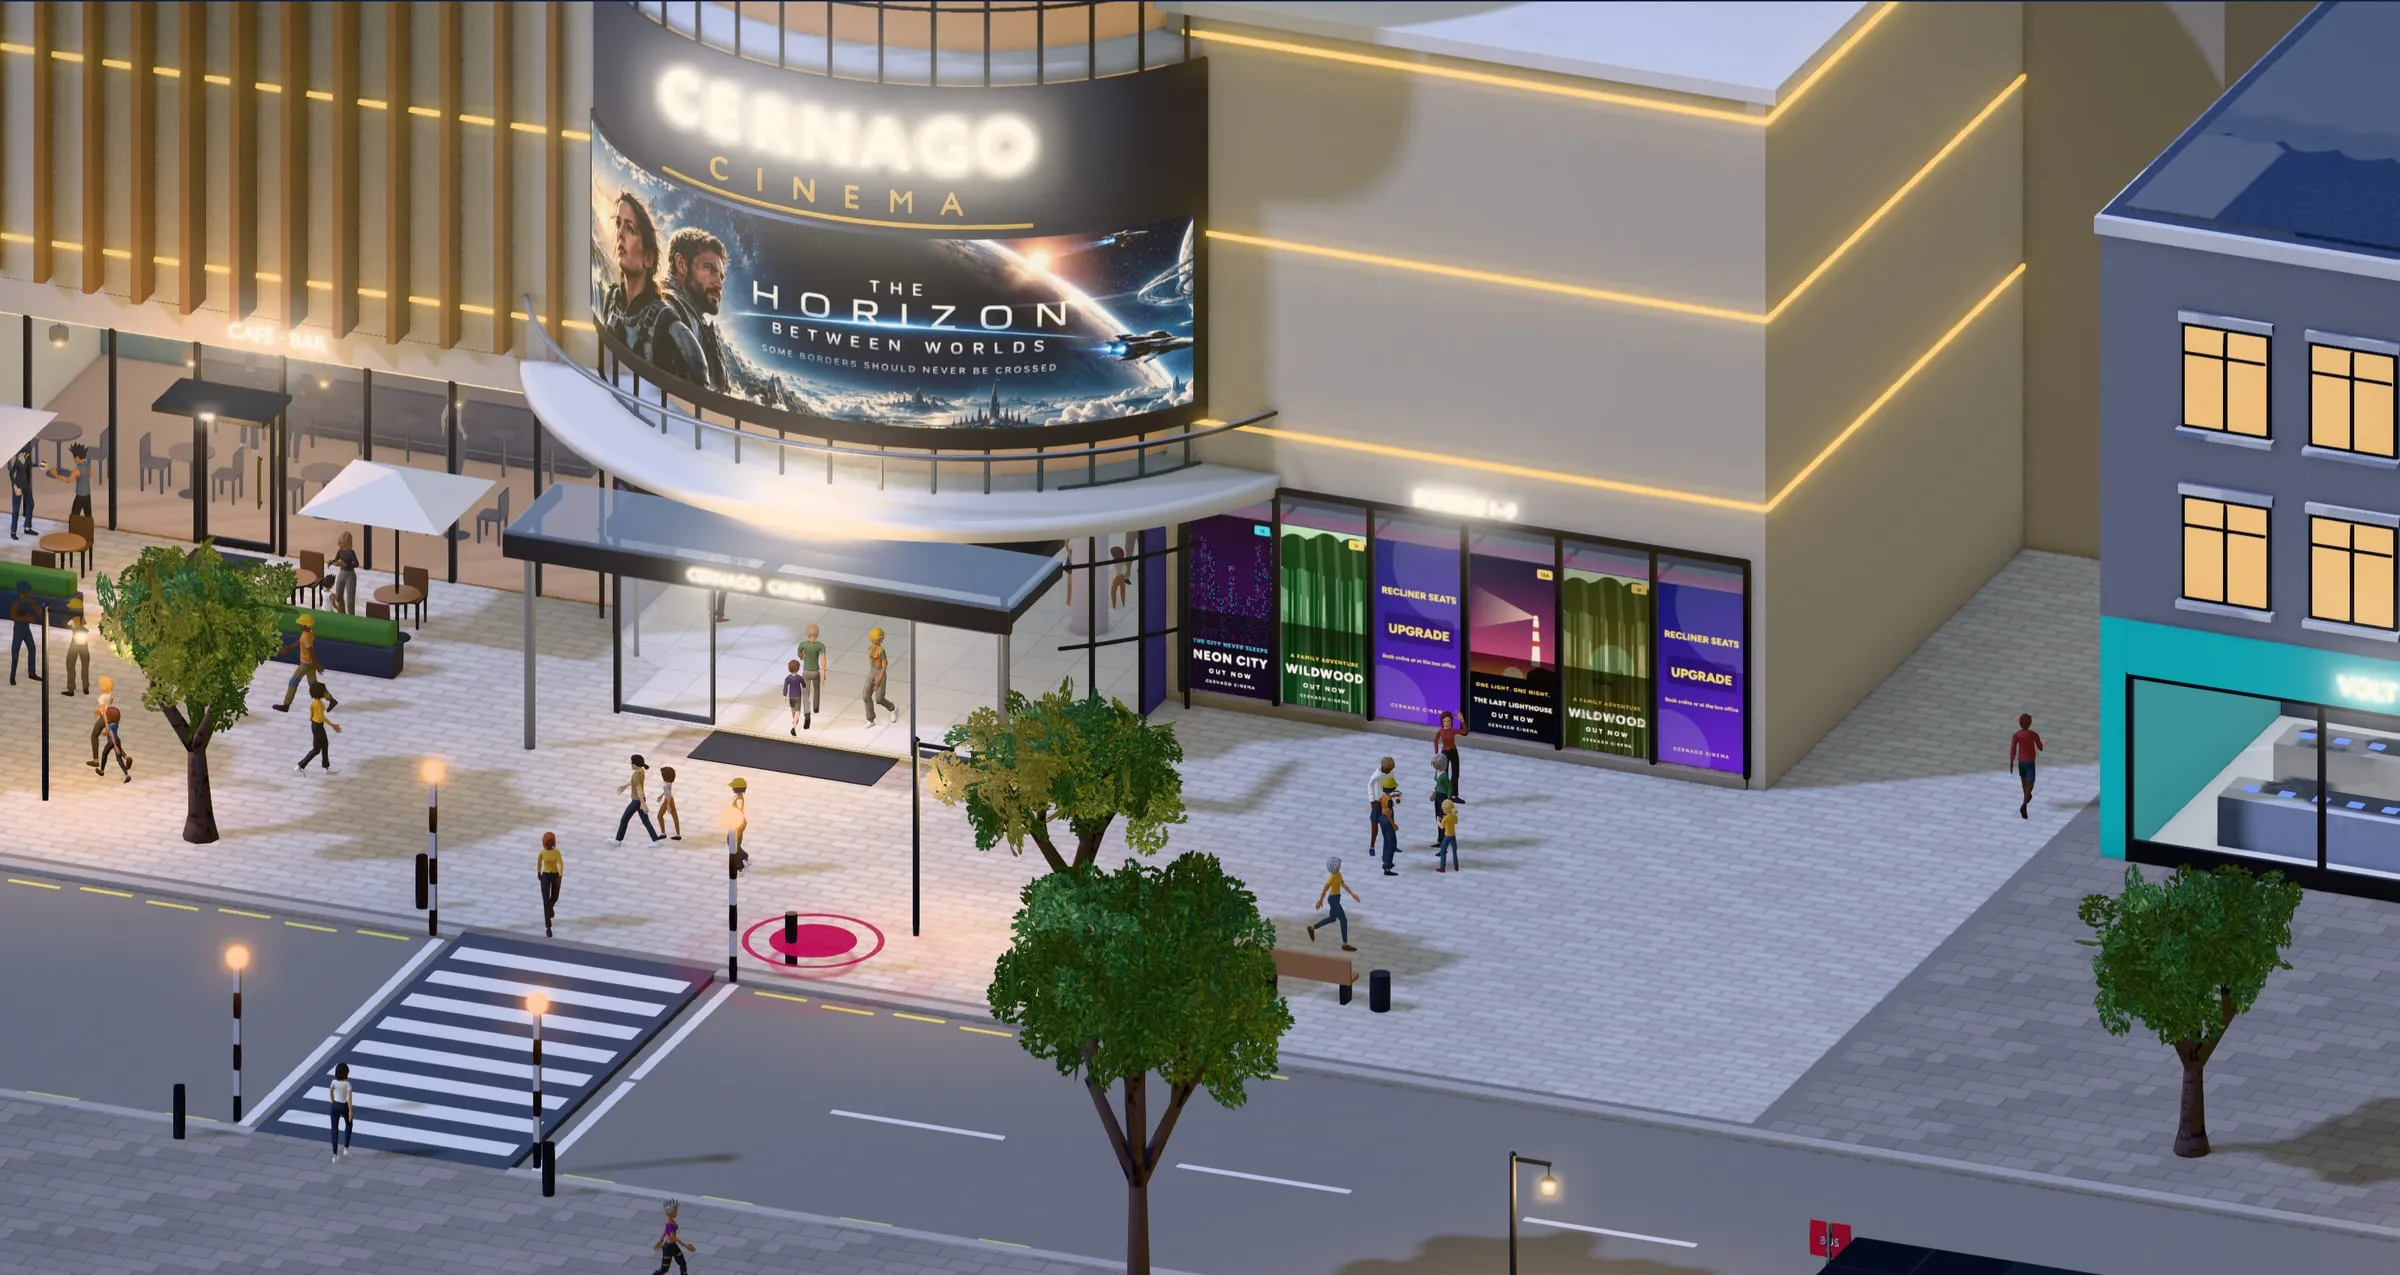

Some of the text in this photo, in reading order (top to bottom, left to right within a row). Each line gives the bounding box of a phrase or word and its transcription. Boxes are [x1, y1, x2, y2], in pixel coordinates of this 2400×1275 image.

[659, 67, 1035, 177] CERNAGO
[709, 156, 964, 217] CINEMA
[869, 280, 923, 297] THE
[752, 280, 1067, 331] HORIZON
[290, 331, 327, 354] BAR
[772, 321, 1045, 355] BETWEEN WORLDS
[761, 344, 1057, 375] SOME BORDERS SHOULD NEVER BE CROSSED
[686, 567, 825, 602] CERNAGO CINEMA
[1381, 585, 1457, 605] RECLINER SEATS
[1388, 622, 1450, 642] UPGRADE
[1664, 629, 1740, 649] RECLINER SEATS
[1223, 642, 1244, 650] NEVER
[1245, 645, 1268, 654] SLEEPS
[1193, 648, 1268, 670] NEON CITY
[1297, 653, 1319, 662] FAMILY
[1321, 657, 1359, 668] ADVENTURE
[1208, 667, 1251, 680] OUT NOW
[1285, 662, 1364, 684] WILDWOOD
[1670, 666, 1733, 686] UPGRADE
[1233, 682, 1256, 690] CINEMA
[1302, 682, 1346, 694] OUT NOW
[2336, 674, 2399, 704] VOLT
[1422, 705, 1445, 715] CINEM
[1473, 696, 1553, 714] THE LAST LIGHTHOUSE
[1579, 697, 1602, 705] FAMILY
[1604, 702, 1641, 712] ADVENTURE
[1491, 711, 1534, 723] OUT NOW
[1568, 706, 1647, 728] WILDWOOD
[1516, 726, 1538, 734] CINEMA
[1585, 726, 1628, 738] OUT NOW
[1610, 741, 1632, 749] CINEMA
[1705, 751, 1729, 760] CINEMA
